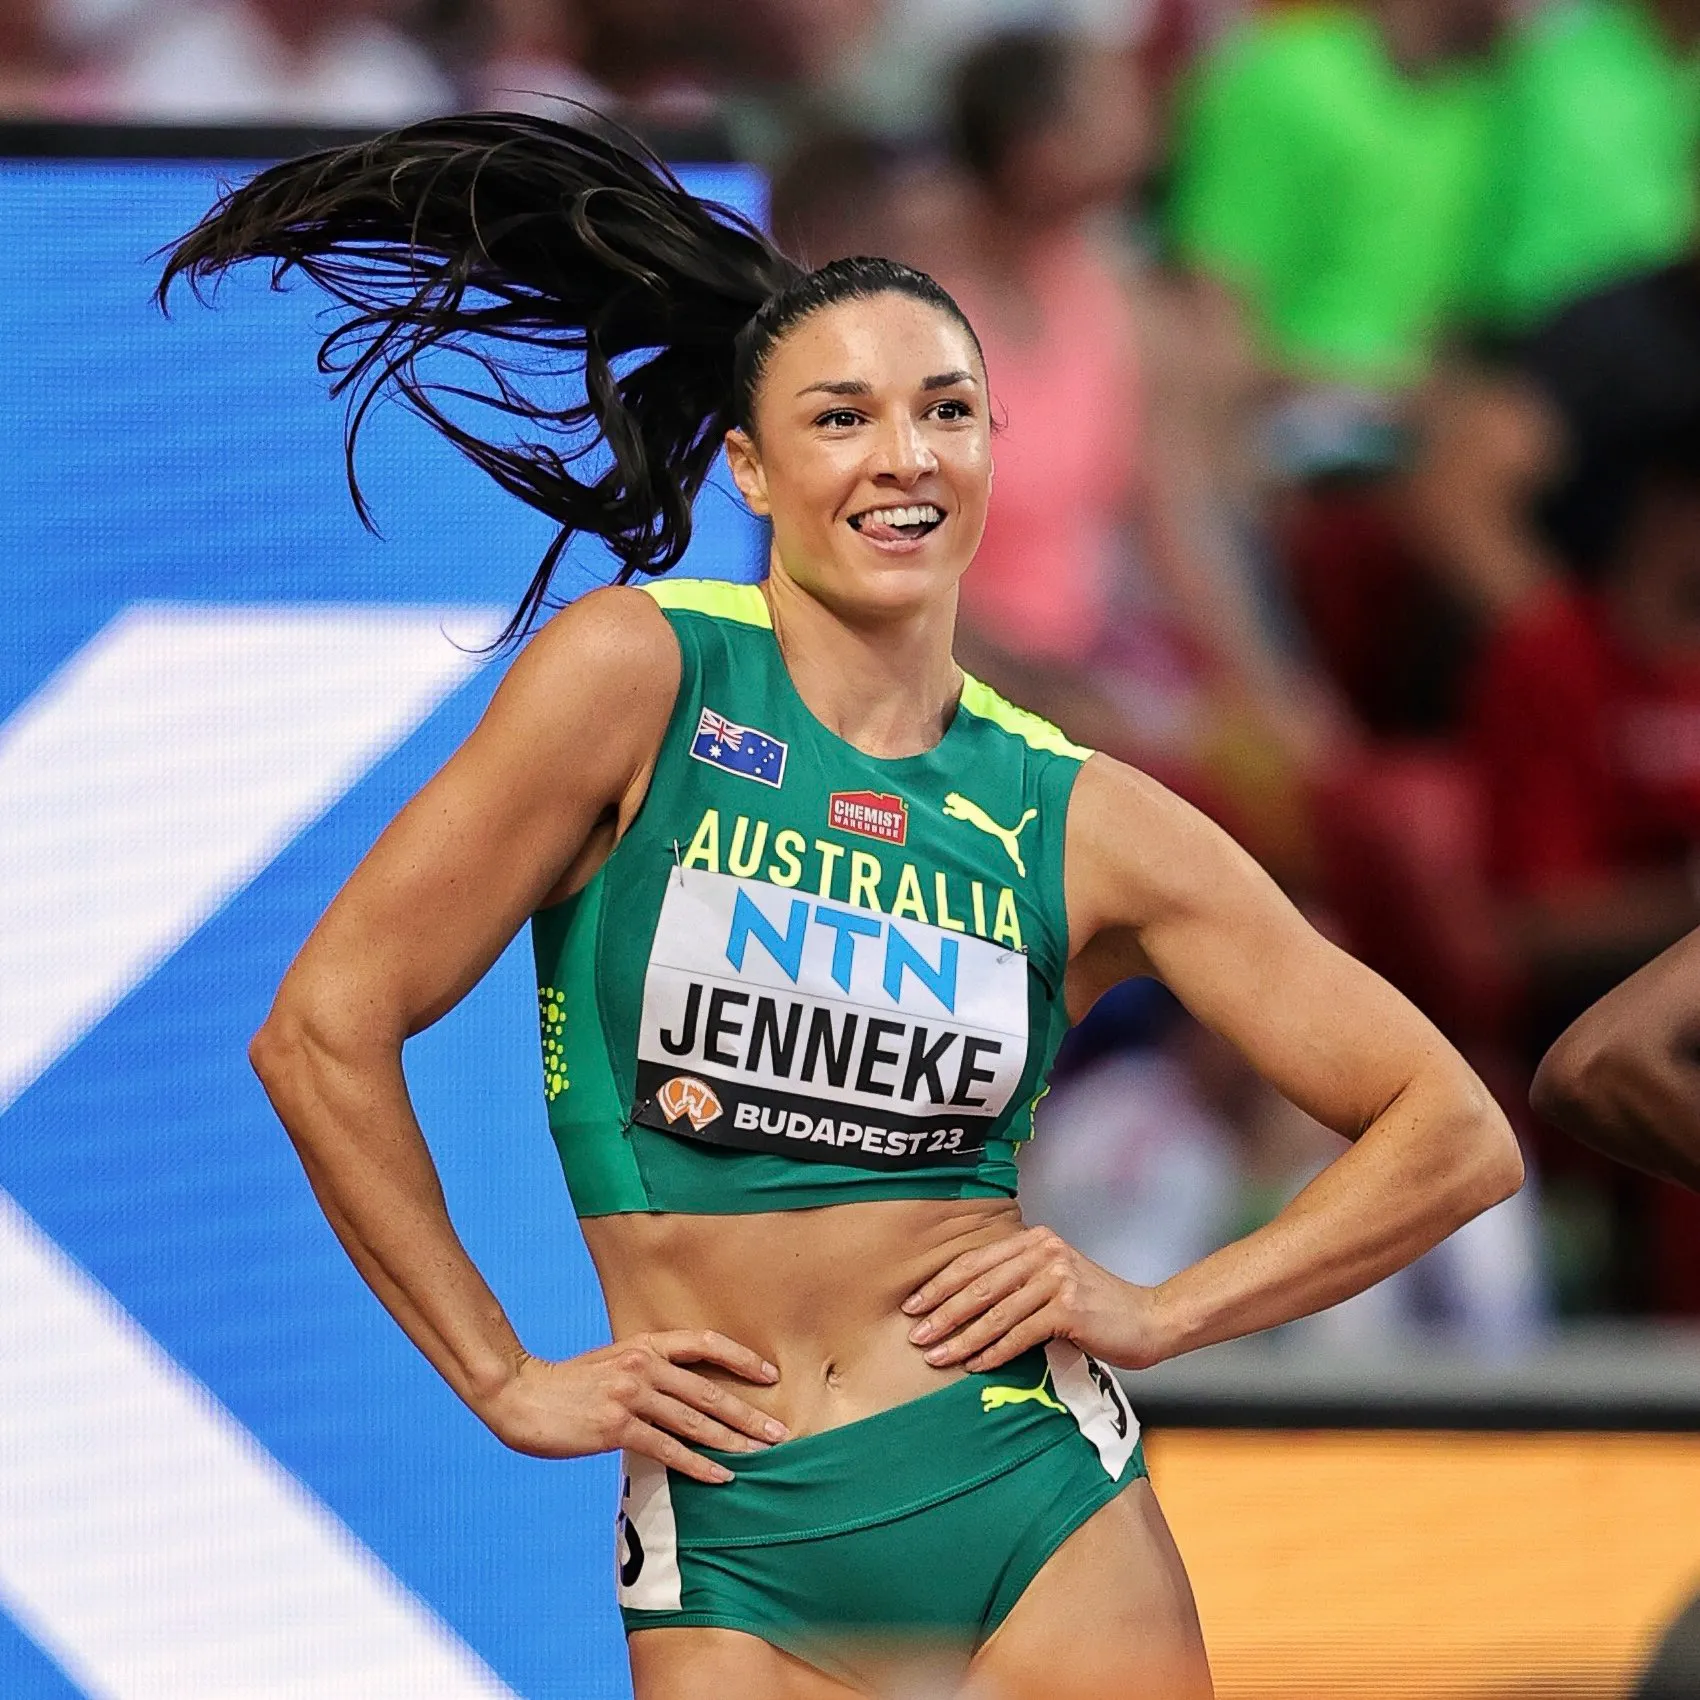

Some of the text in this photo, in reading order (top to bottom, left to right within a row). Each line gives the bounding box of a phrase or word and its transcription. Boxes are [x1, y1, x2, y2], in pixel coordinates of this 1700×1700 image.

[834, 799, 902, 829] CHEMIST
[834, 814, 899, 838] WAREHOUSE
[683, 809, 1023, 950] AUSTRALIA
[726, 887, 958, 1016] NTN
[660, 982, 1002, 1108] JENNEKE
[733, 1102, 964, 1156] BUDAPEST 23
